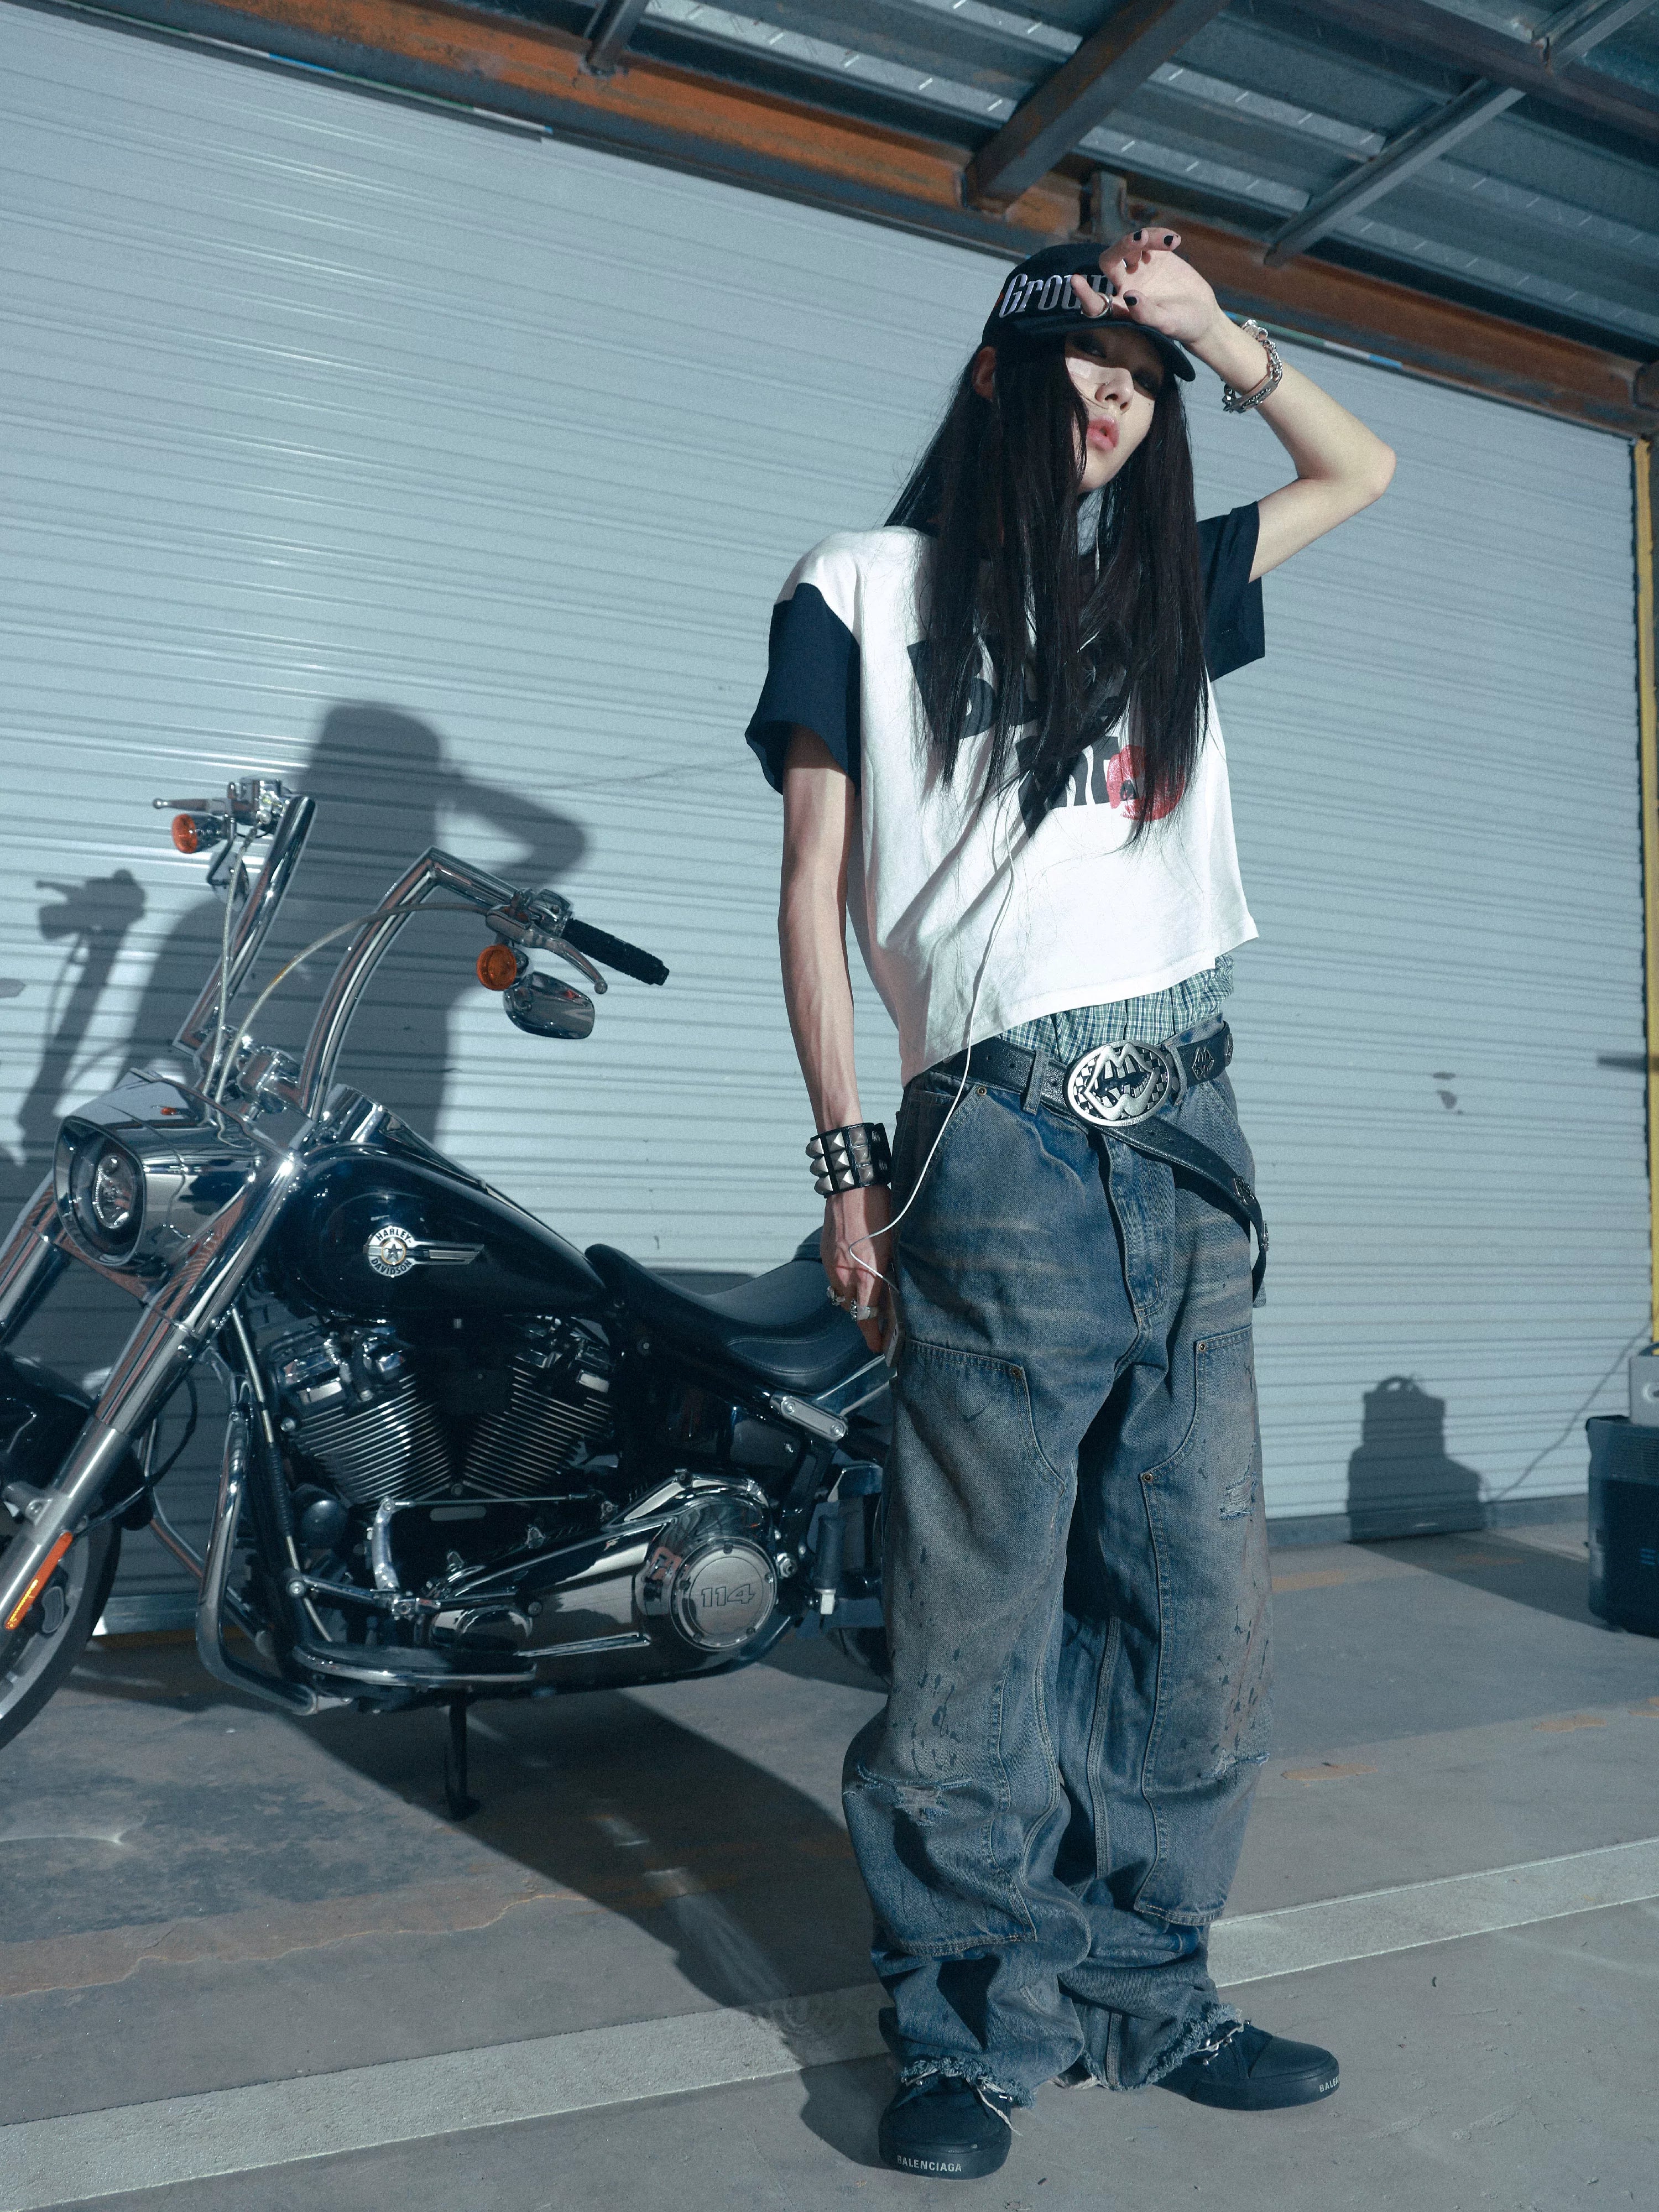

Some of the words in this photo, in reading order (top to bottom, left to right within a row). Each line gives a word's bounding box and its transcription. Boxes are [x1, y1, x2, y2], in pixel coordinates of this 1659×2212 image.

[371, 1258, 413, 1275] DAVIDSON
[701, 1583, 755, 1608] 114
[896, 2154, 962, 2172] BALENCIAGA
